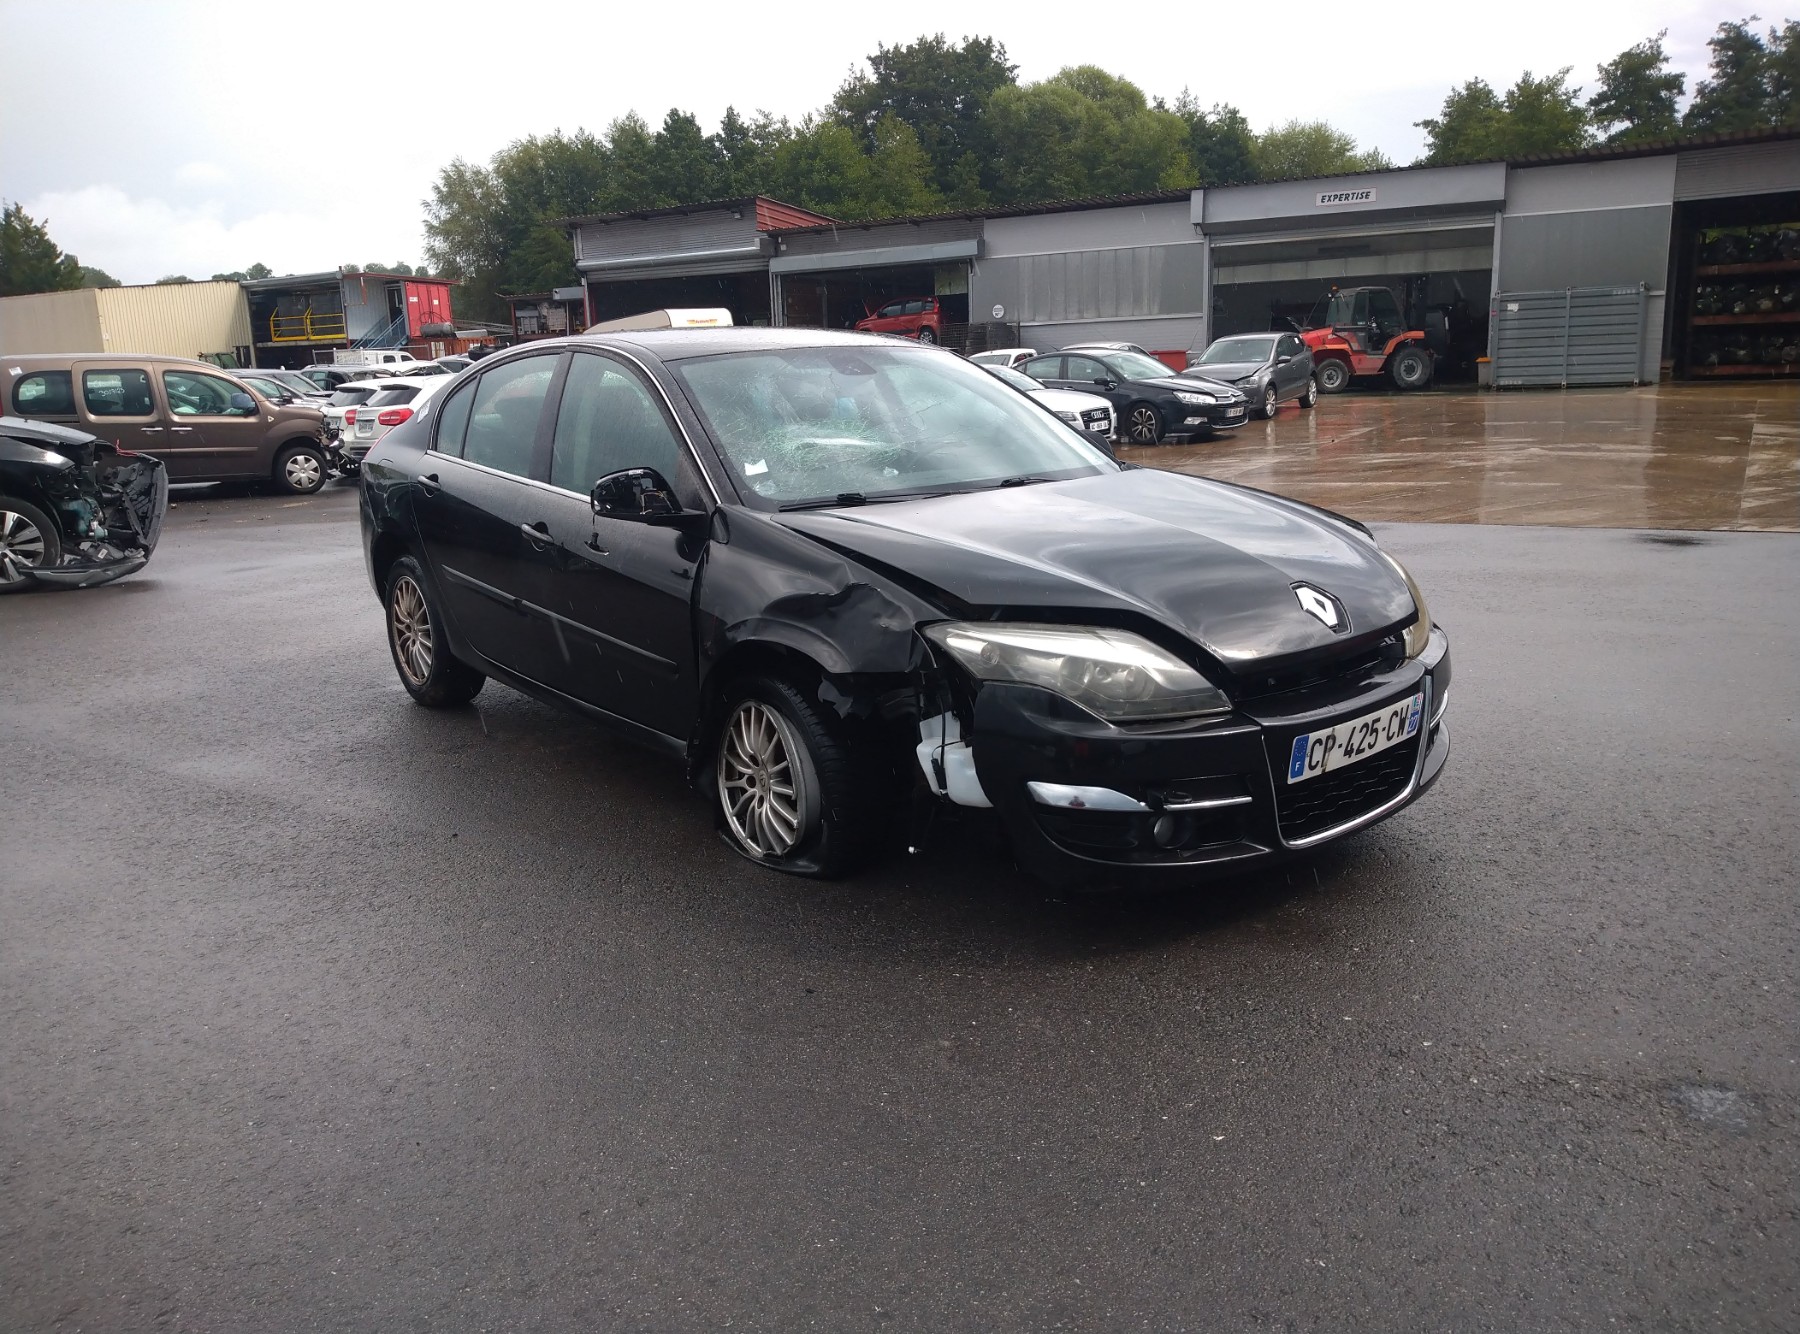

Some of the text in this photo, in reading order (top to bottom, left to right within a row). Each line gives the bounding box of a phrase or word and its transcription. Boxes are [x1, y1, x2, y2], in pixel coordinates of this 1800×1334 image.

[1321, 191, 1371, 203] EXPERTISE
[1307, 704, 1409, 771] CP-425-CW
[1295, 761, 1301, 772] F
